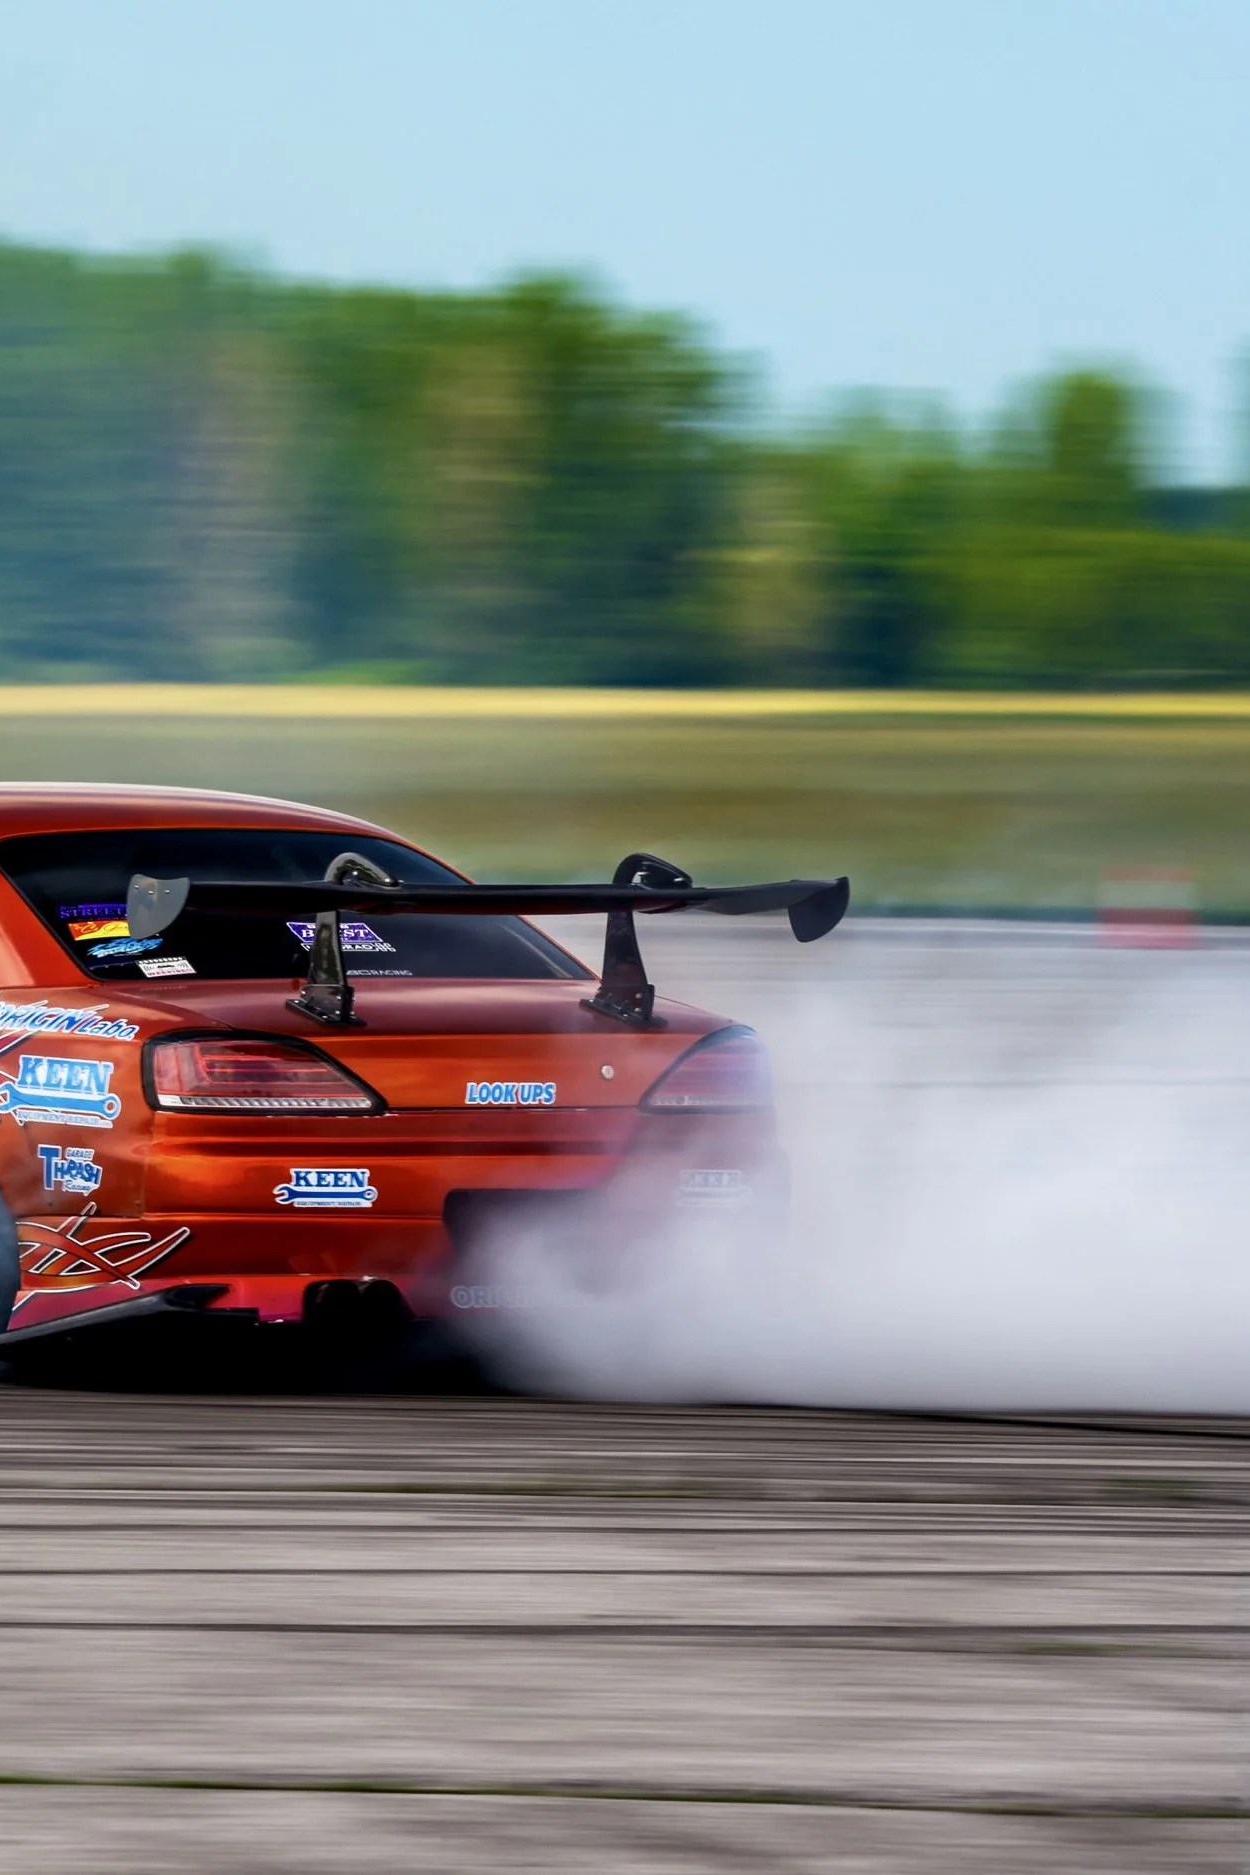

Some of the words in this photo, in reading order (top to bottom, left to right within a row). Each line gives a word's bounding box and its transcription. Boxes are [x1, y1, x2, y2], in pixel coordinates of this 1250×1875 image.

[18, 1056, 113, 1095] KEEN
[466, 1083, 516, 1104] LOOK
[519, 1083, 556, 1103] UPS
[66, 1149, 93, 1159] GARAGE
[293, 1170, 367, 1188] KEEN
